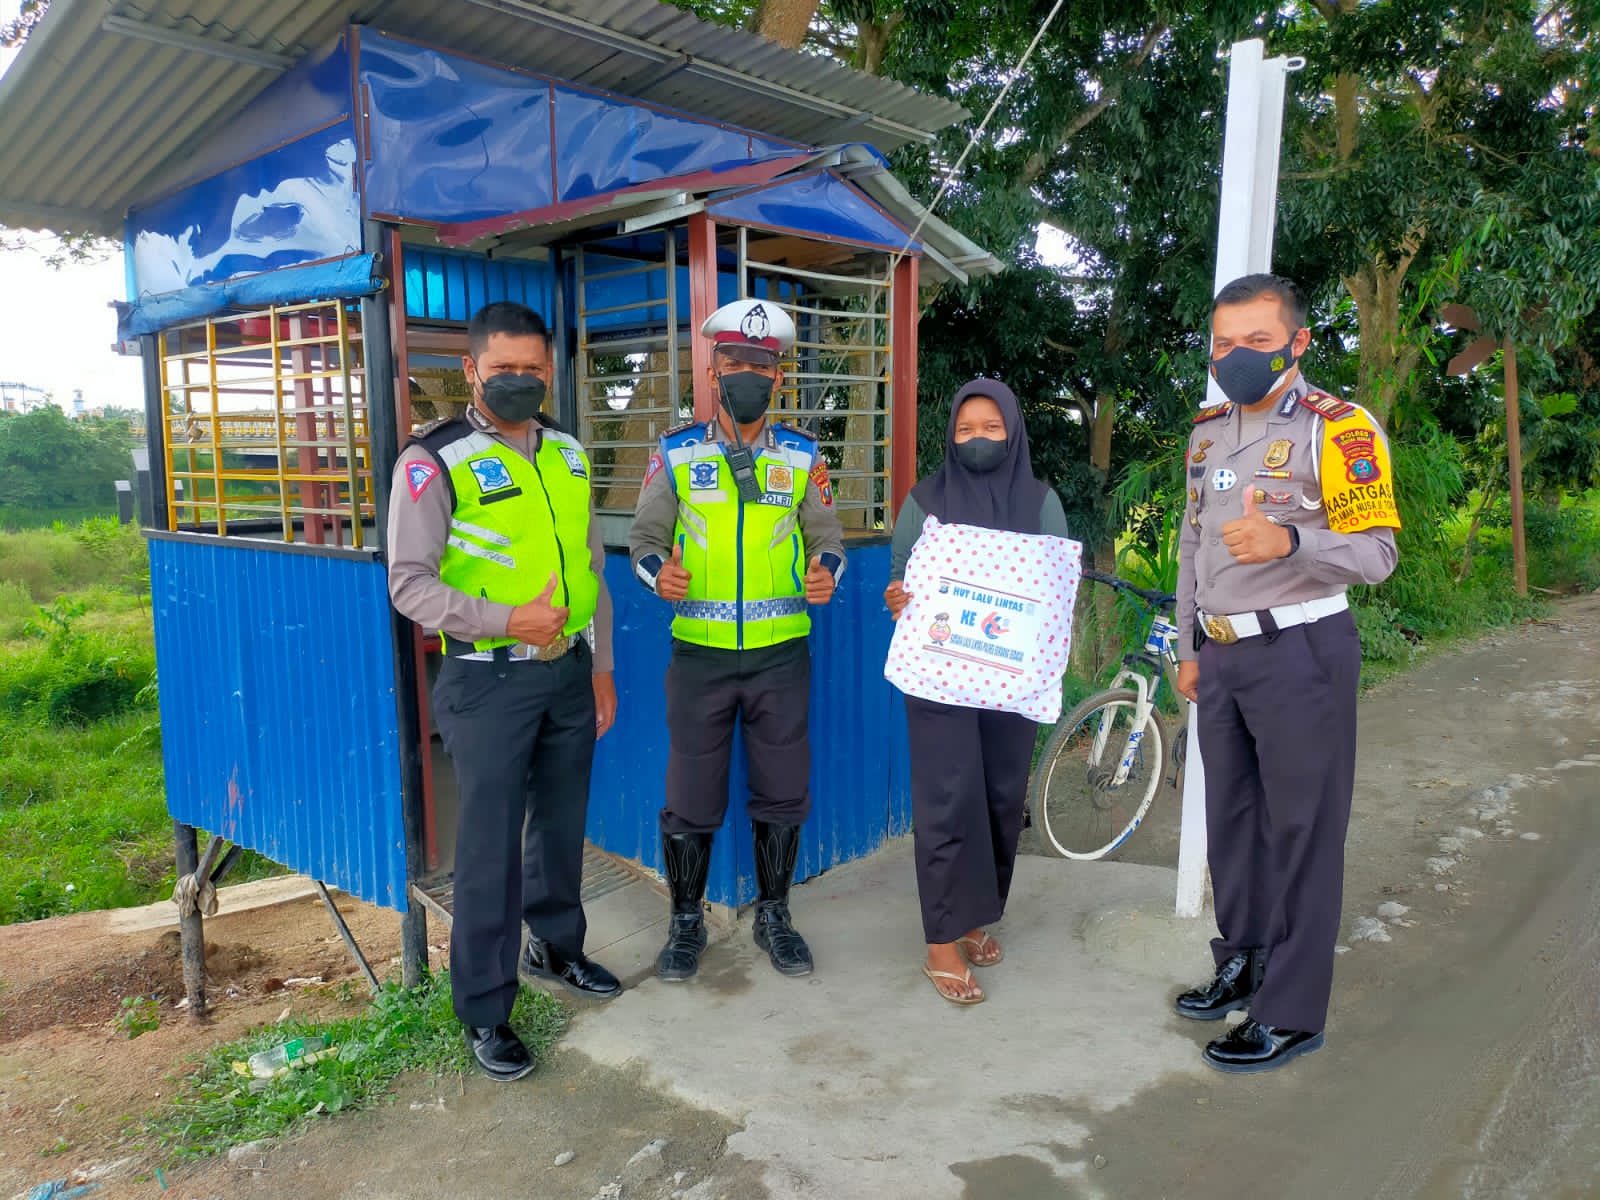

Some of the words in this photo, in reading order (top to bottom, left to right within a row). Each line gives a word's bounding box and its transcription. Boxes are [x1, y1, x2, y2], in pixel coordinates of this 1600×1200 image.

[758, 494, 791, 506] POLRI
[1327, 483, 1392, 514] KASATGAS
[1356, 501, 1376, 512] NUSA
[953, 586, 970, 599] HUT
[972, 591, 993, 605] LALU
[994, 597, 1023, 612] LINTAS
[960, 609, 977, 627] KE
